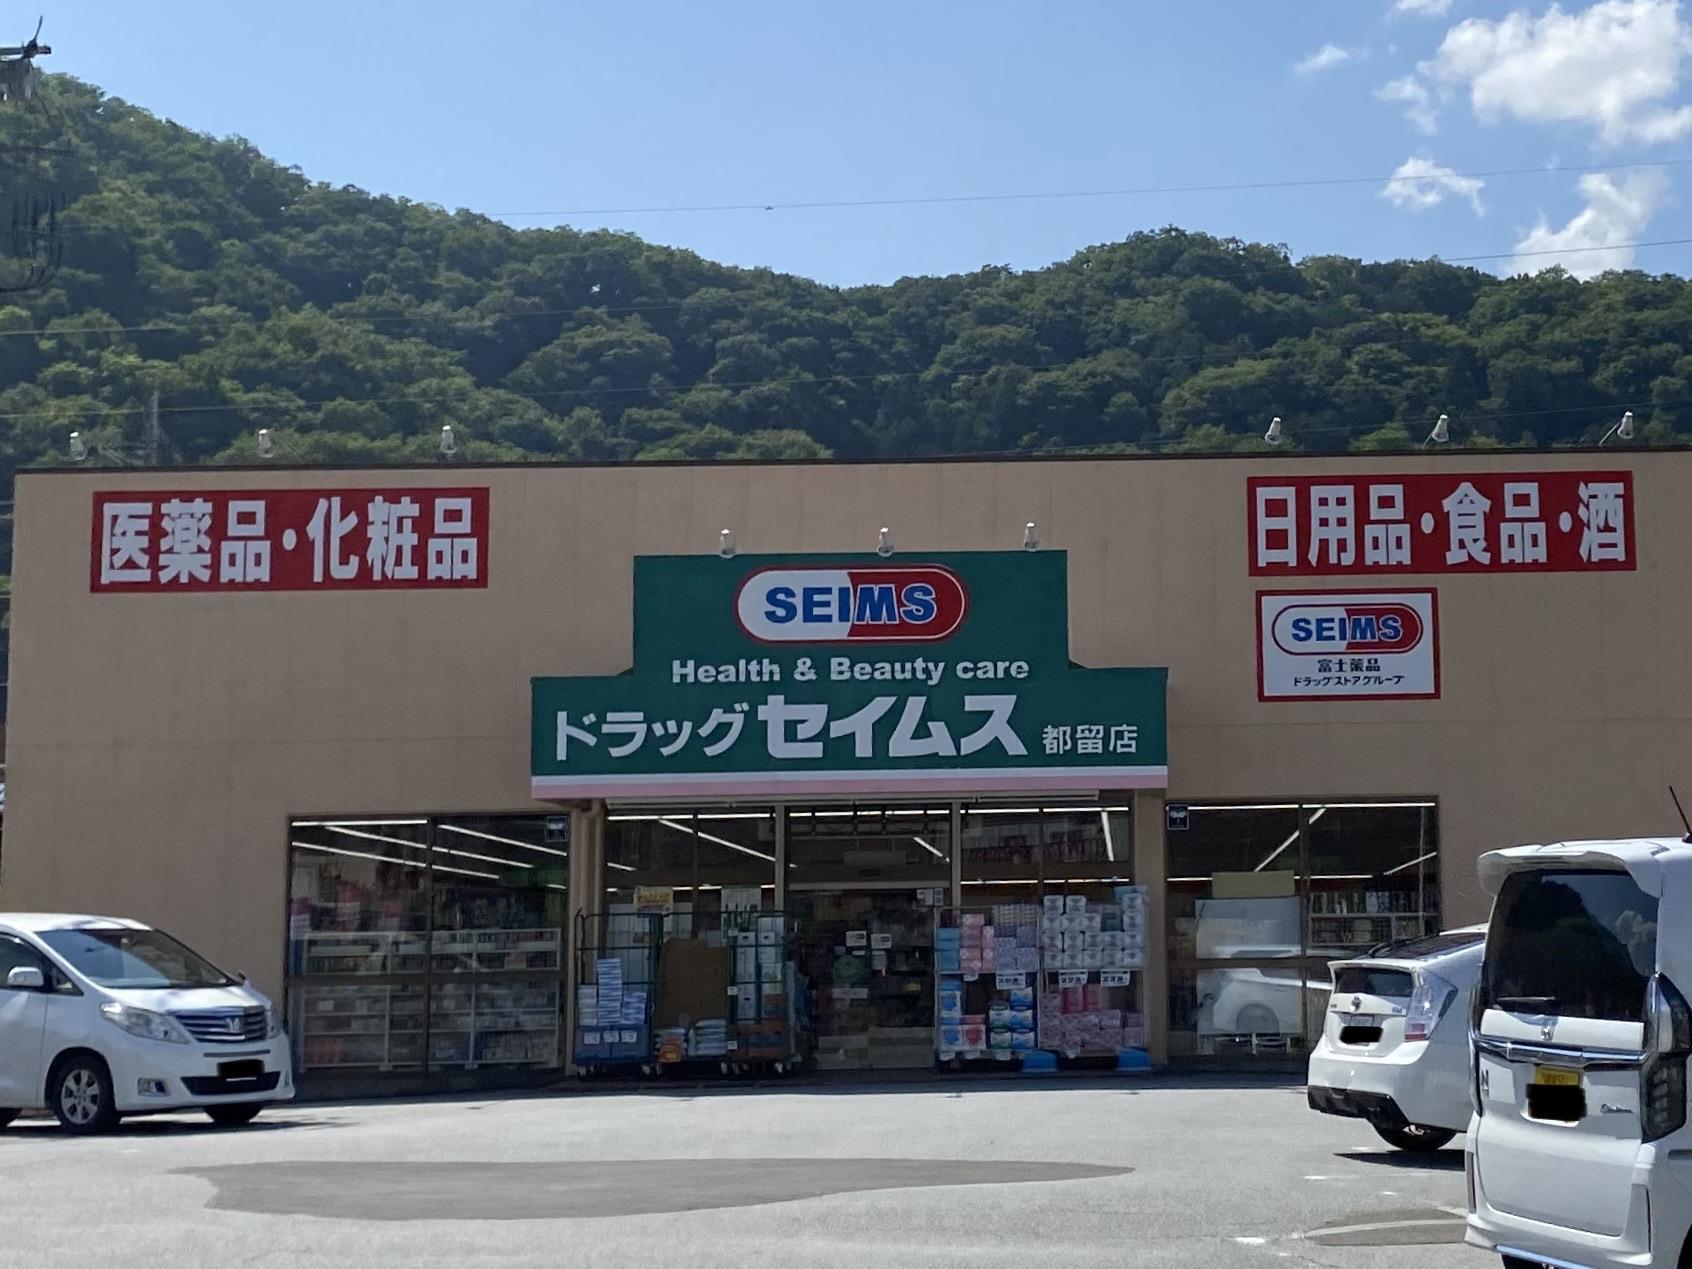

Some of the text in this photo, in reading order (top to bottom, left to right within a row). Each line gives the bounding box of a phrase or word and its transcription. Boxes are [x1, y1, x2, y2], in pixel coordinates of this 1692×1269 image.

[100, 495, 479, 584] 医薬品・化粧品
[1255, 480, 1627, 567] 日用品・食品・酒
[763, 583, 938, 624] SEIMS
[1291, 614, 1403, 643] SEIMS
[671, 655, 1030, 685] Health & Beauty care
[1317, 657, 1381, 673] 富士薬品
[556, 693, 1139, 761] ドラッグ セイムス 都留店
